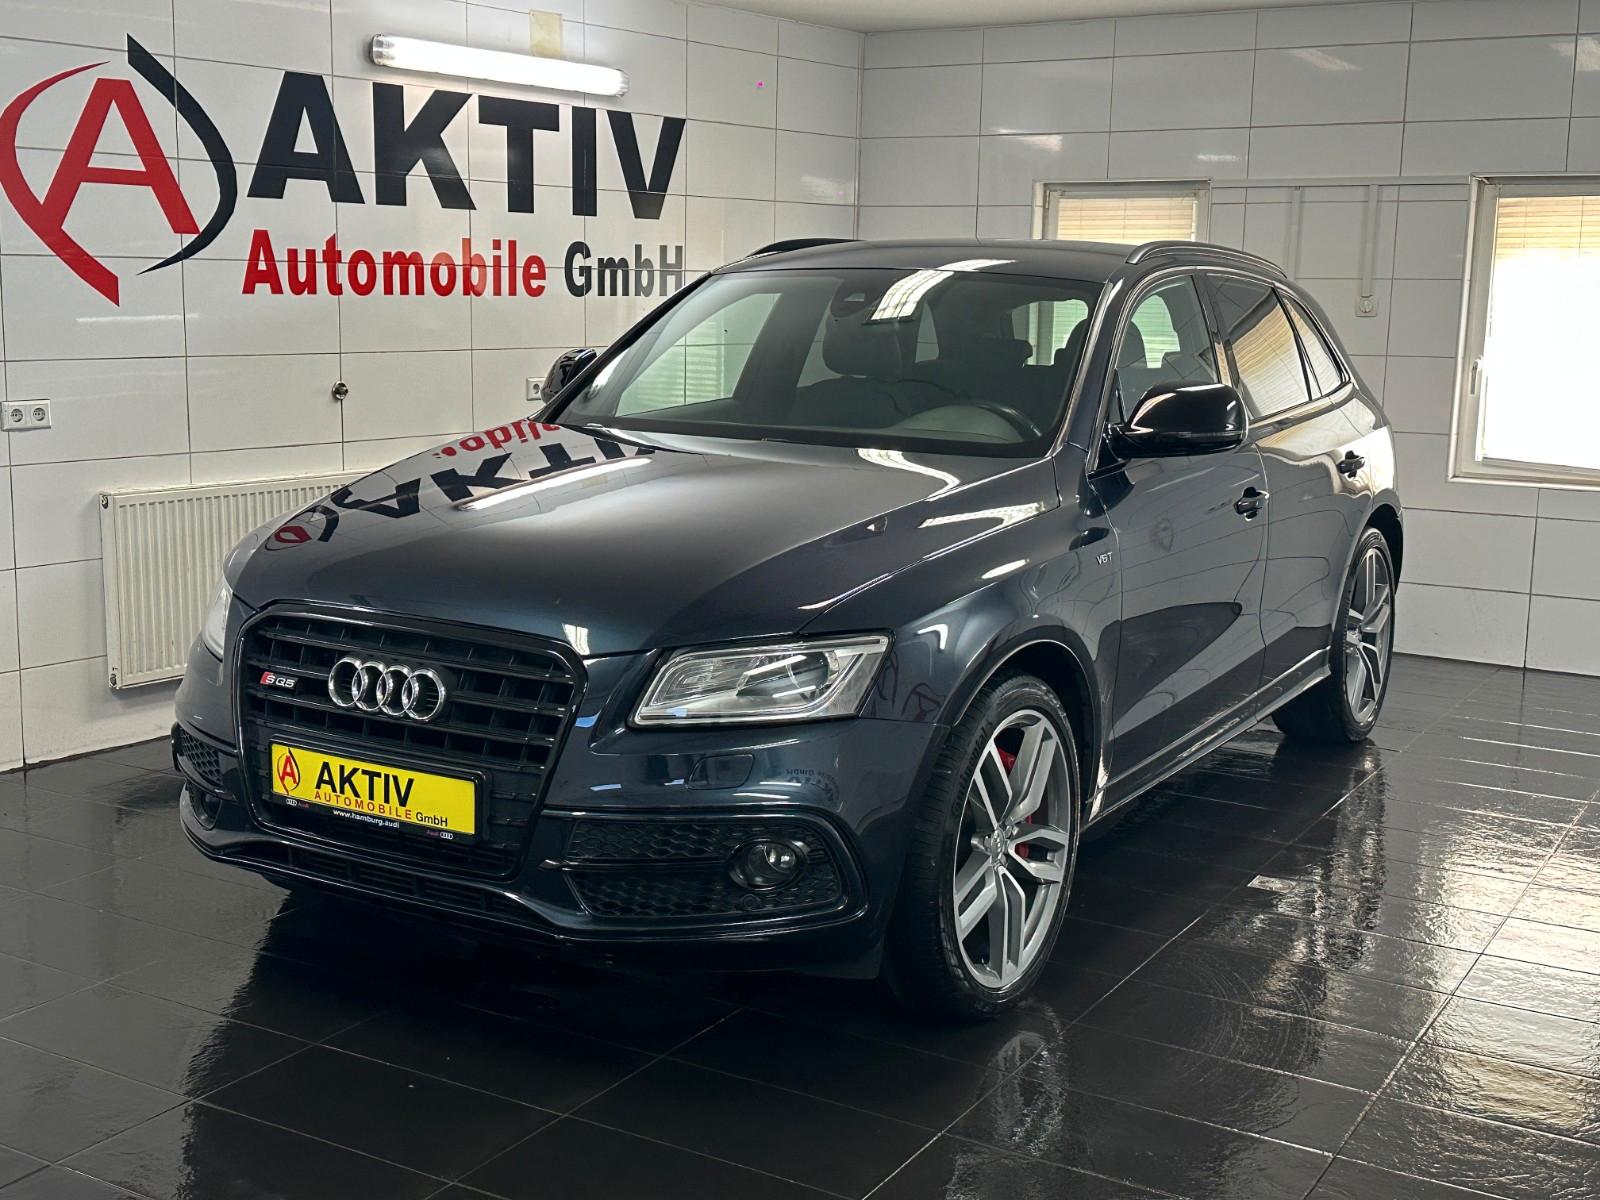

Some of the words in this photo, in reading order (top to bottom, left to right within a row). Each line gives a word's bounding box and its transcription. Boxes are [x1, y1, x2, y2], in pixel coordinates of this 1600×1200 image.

[247, 70, 686, 220] AKTIV
[241, 228, 547, 297] Automobile
[564, 240, 684, 298] GmbH
[265, 674, 296, 688] SQ5
[315, 761, 415, 808] AKTIV
[314, 790, 412, 820] AUTOMOBILE
[416, 811, 448, 827] GmbH
[332, 809, 400, 828] www.hamburg.audi
